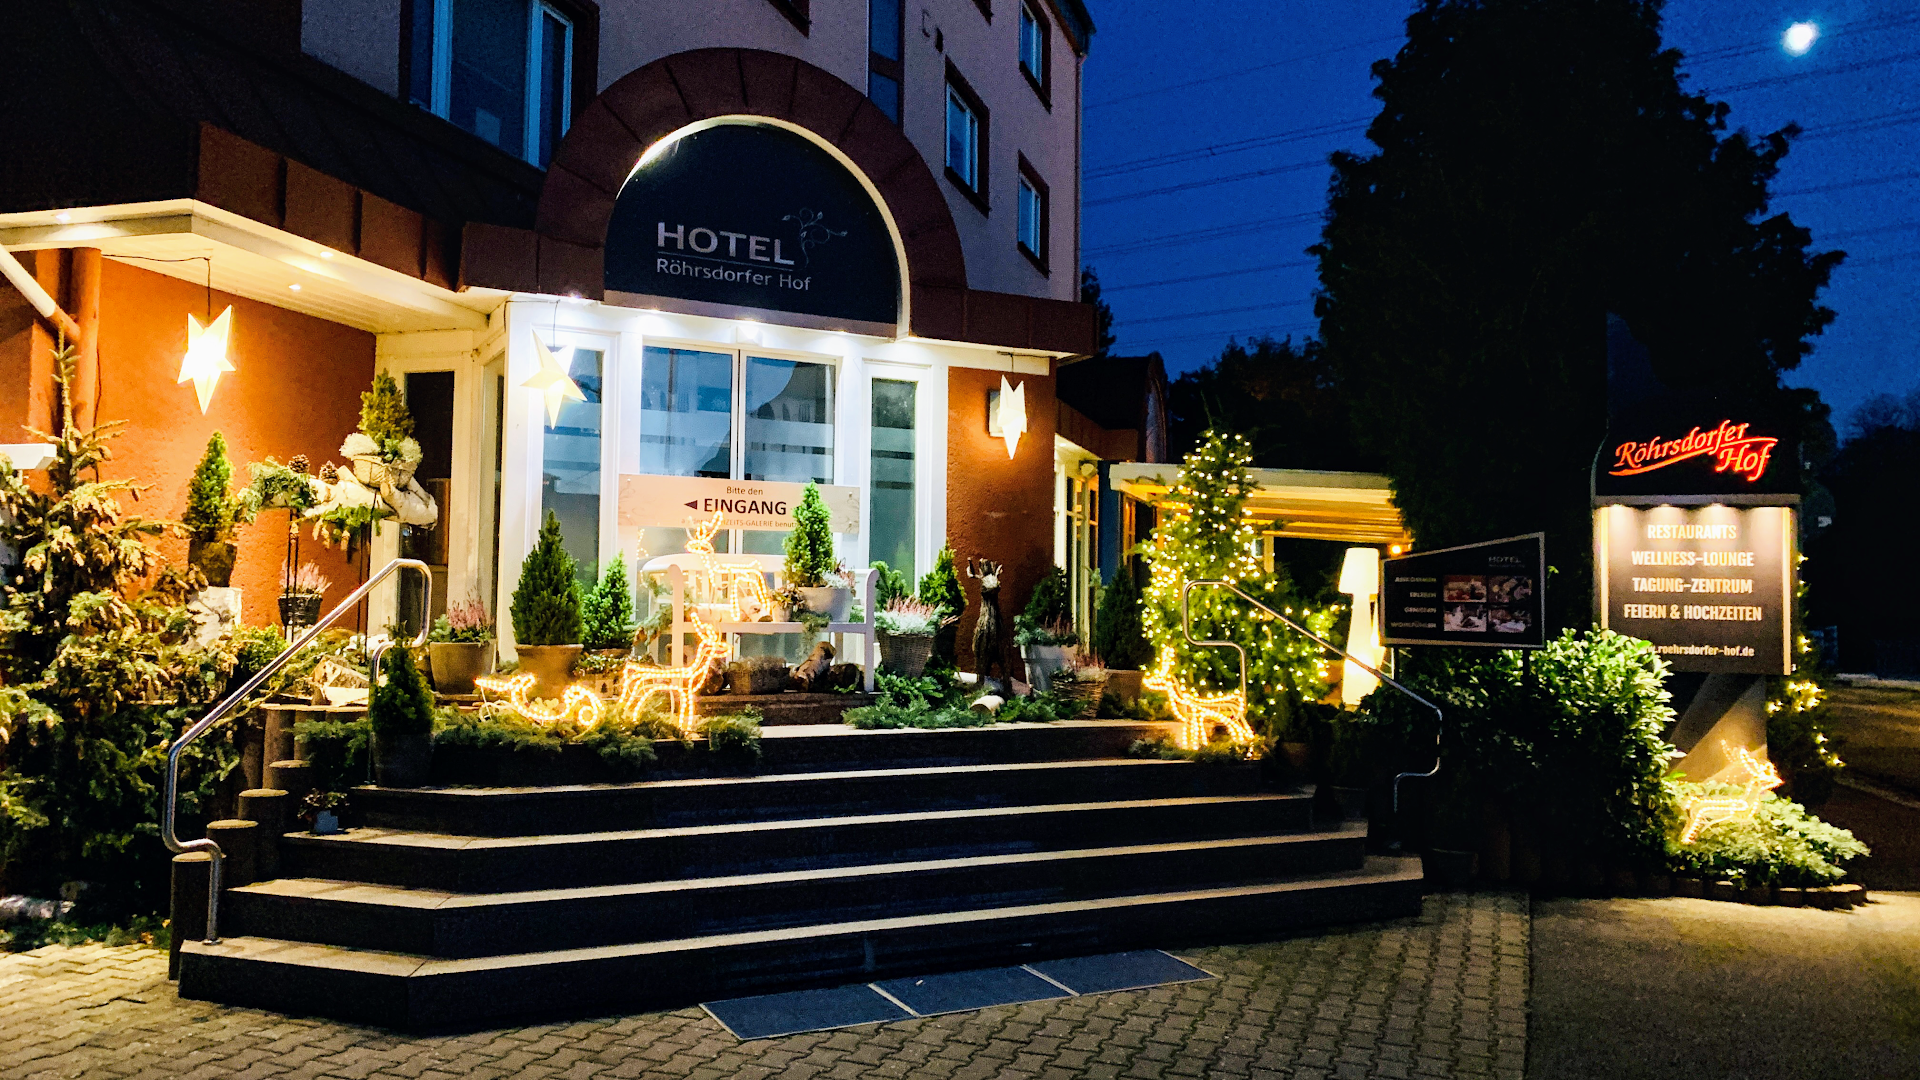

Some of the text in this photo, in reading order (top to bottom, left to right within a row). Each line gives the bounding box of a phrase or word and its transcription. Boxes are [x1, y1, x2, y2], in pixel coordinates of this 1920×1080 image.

[657, 221, 795, 266] HOTEL
[656, 257, 812, 291] Röhrsdorfer Hof
[1614, 419, 1777, 482] Röhrsdorfer Hof
[726, 485, 764, 496] Bitte den
[703, 498, 787, 516] EINGANG
[1647, 524, 1737, 540] RESTAURANTS
[1488, 555, 1522, 564] HOTEL
[1631, 550, 1755, 567] WELLNESS-LOUNGE
[1631, 577, 1753, 594] TAGUNG-ZENTRUM
[1623, 603, 1762, 621] FEIERN & HOCHZEITEN
[1645, 643, 1755, 658] w.roehrsdorfer-hof.de
